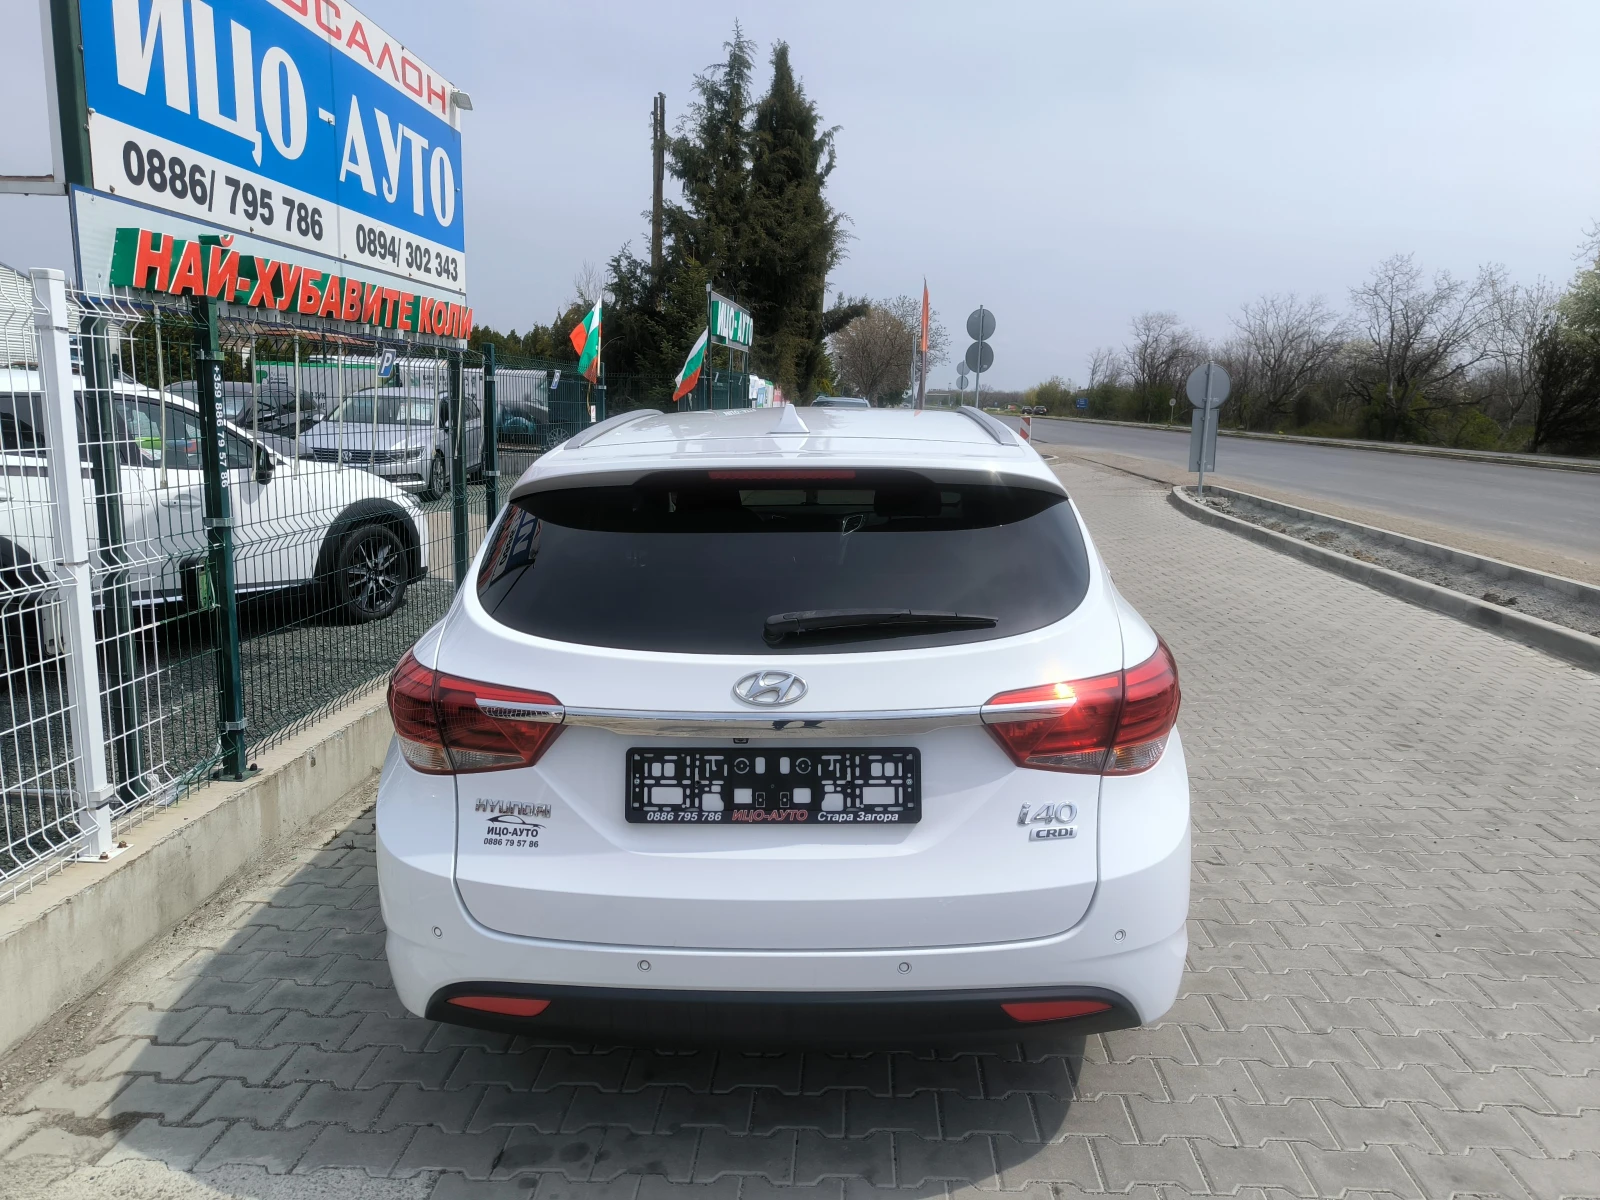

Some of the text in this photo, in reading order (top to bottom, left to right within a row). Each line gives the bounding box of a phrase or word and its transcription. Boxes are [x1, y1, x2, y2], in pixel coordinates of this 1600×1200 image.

[123, 140, 324, 241] 0886/ 795 786
[355, 224, 459, 282] 0894/ 302 343
[132, 228, 474, 340] НАЙ-ХУБАВИТЕ КОЛИ
[716, 301, 754, 347] ИЦО-АУТО
[213, 365, 230, 488] +359 886 79 57 86
[475, 798, 551, 818] HYUNDAI
[647, 812, 722, 821] 0886 795 786
[732, 810, 808, 822] ИЦО-АУТО
[817, 812, 899, 823] Стара Загора
[1018, 801, 1078, 825] i40
[487, 826, 538, 837] ИЦО-АУТО
[1036, 828, 1074, 838] CRDi
[483, 838, 539, 848] 0886 79 57 86
